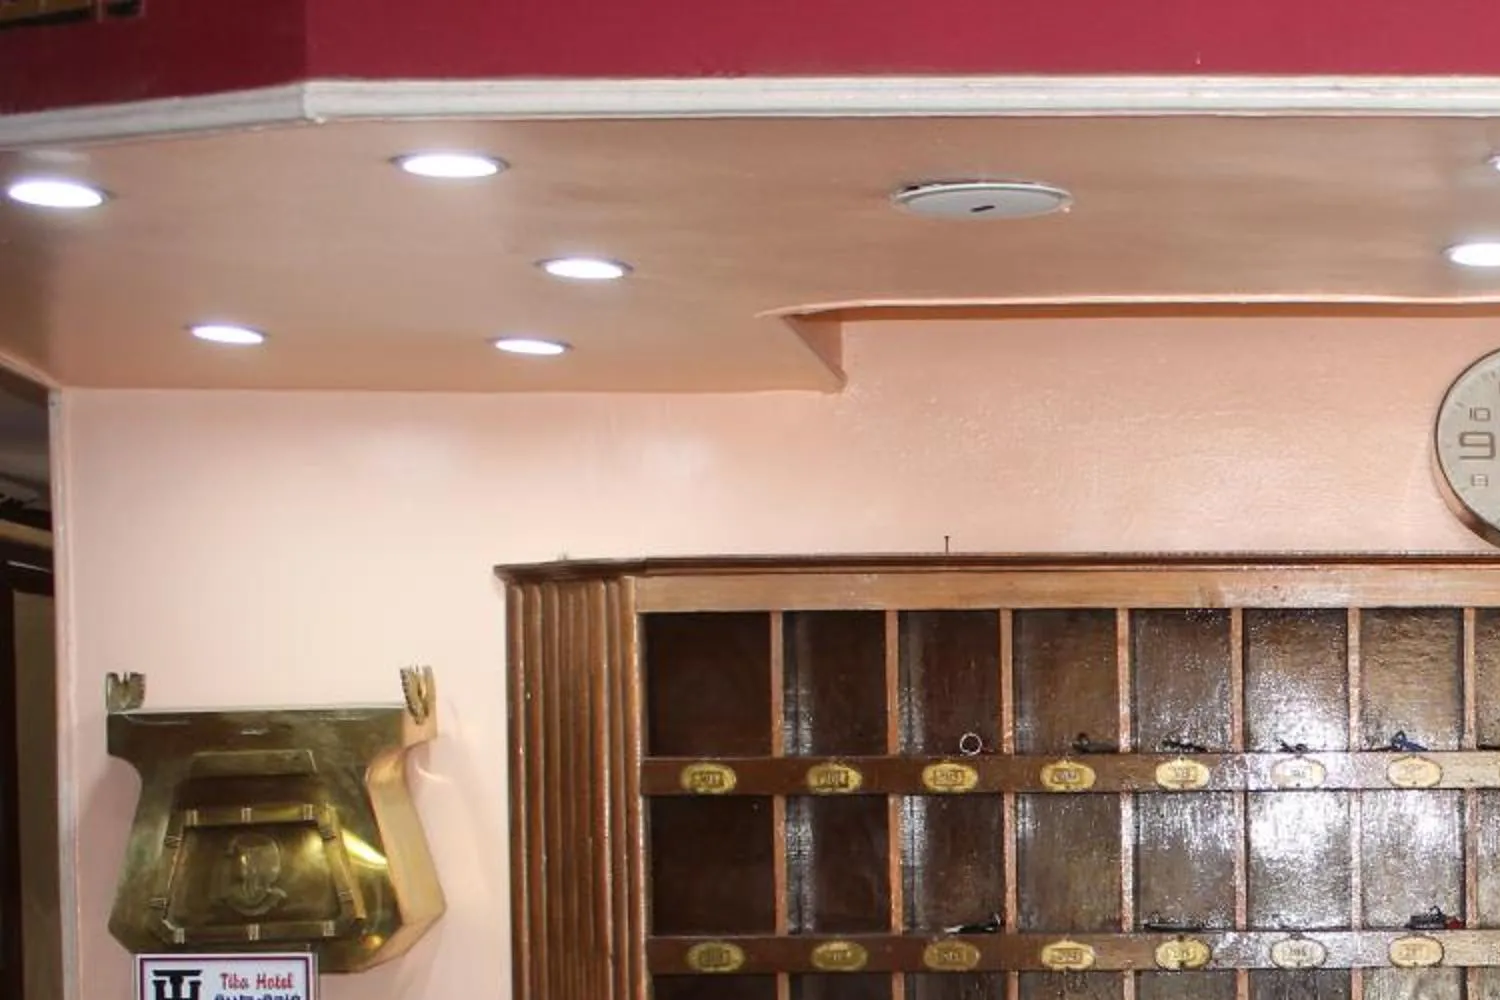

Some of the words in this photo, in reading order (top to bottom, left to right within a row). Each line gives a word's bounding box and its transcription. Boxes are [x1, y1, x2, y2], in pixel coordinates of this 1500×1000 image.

[1469, 407, 1491, 422] 10
[1459, 431, 1496, 460] 9
[1471, 474, 1489, 487] 8
[256, 972, 295, 990] Hotel
